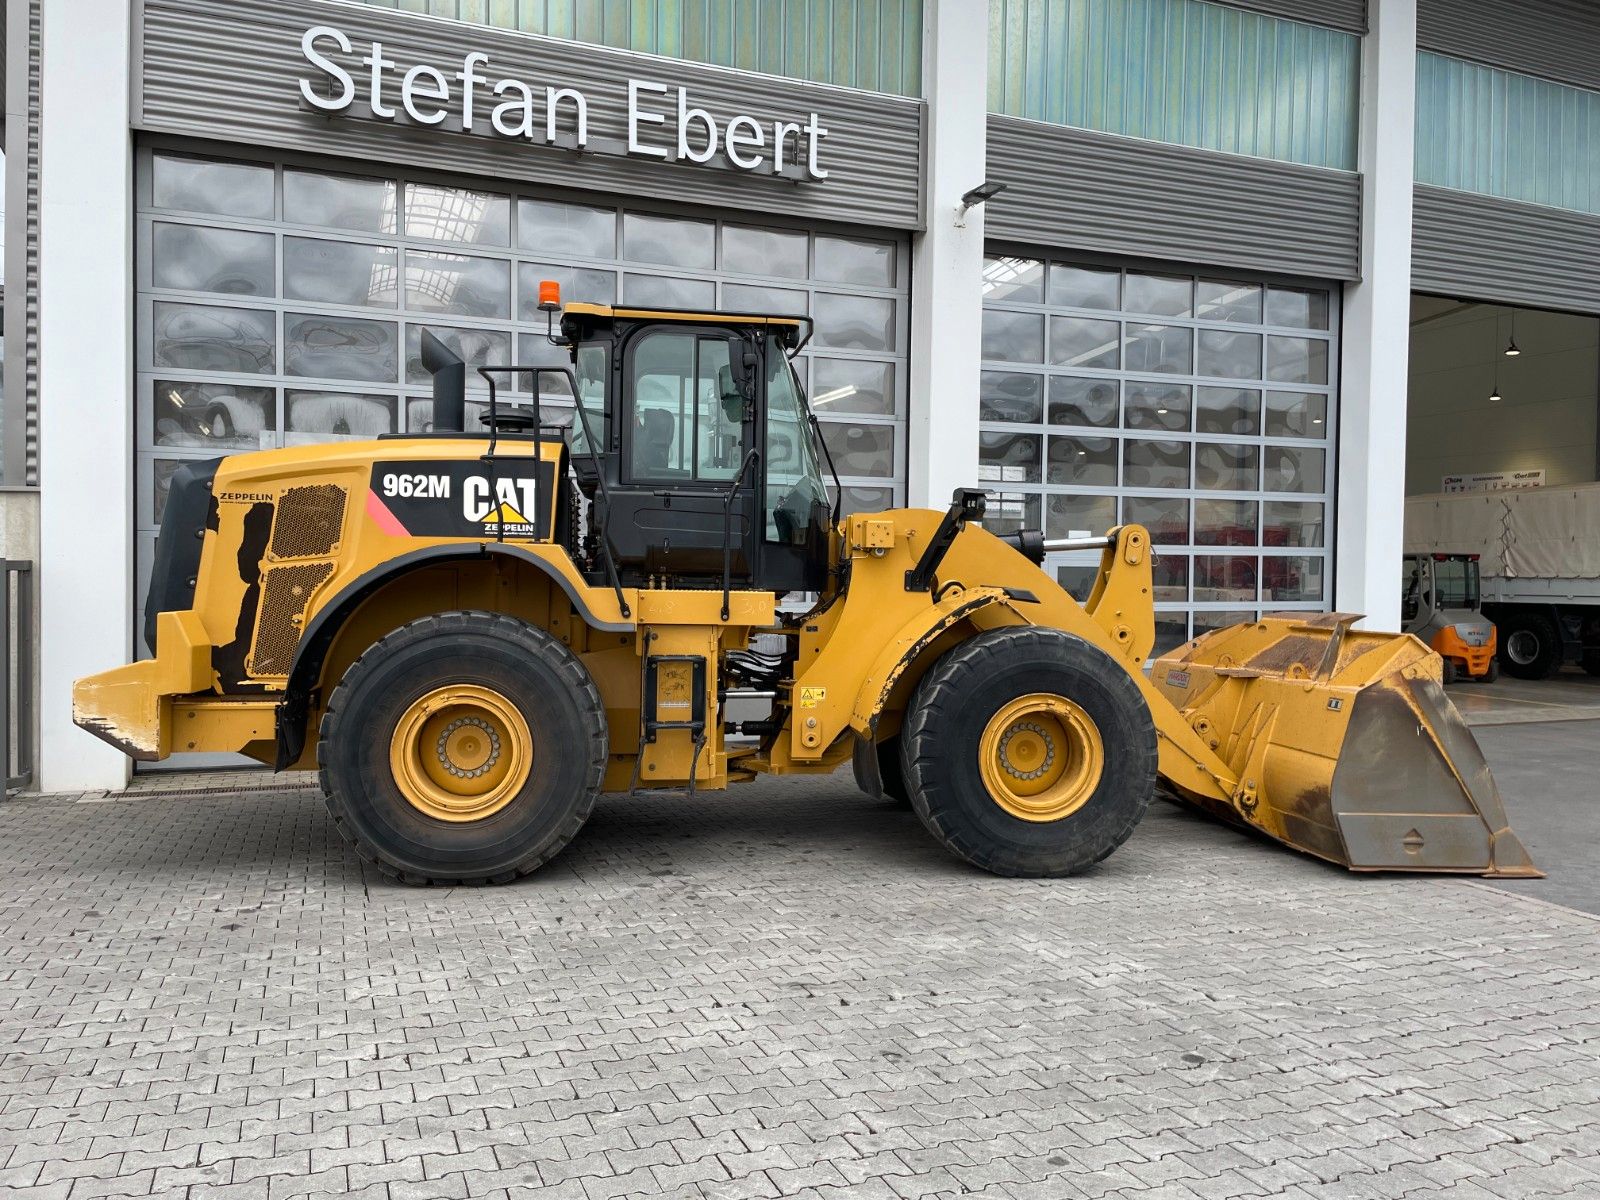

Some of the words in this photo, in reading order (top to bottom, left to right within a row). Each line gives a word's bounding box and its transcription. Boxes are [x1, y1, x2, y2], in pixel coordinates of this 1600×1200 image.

[299, 26, 588, 148] Stefan
[628, 79, 829, 182] Ebert
[219, 492, 273, 501] ZEPPELIN
[383, 473, 450, 498] 962M
[463, 475, 536, 523] CAT
[484, 523, 534, 532] ZEPELIN
